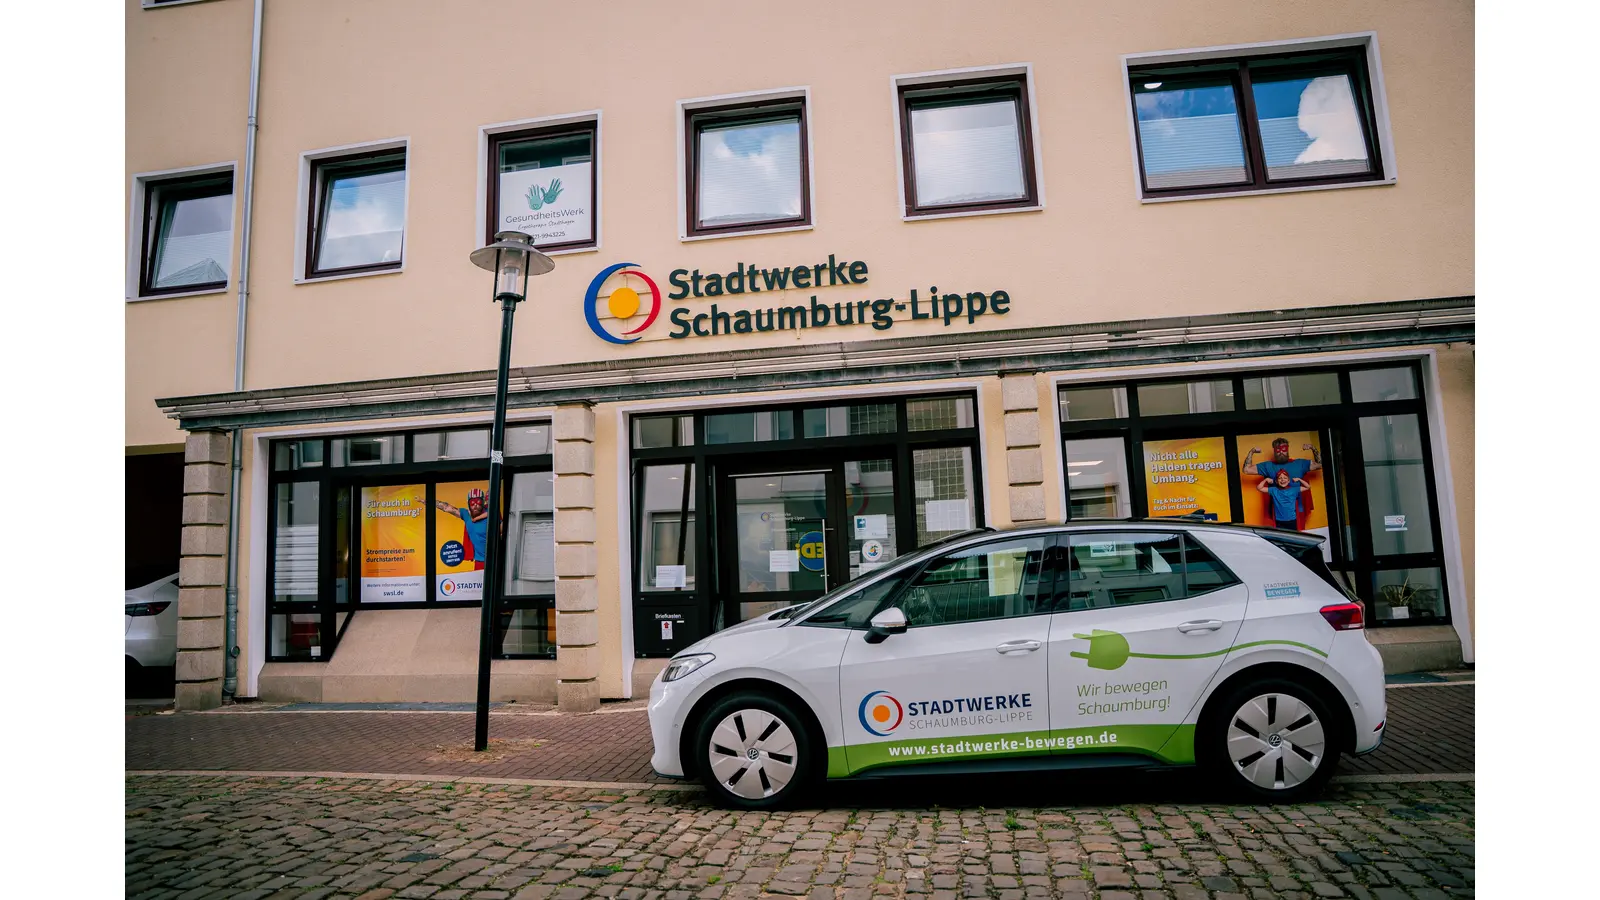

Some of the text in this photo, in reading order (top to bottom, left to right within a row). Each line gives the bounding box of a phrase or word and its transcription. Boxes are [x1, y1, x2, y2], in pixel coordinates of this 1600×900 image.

[505, 207, 585, 224] GesundheitsWerk
[668, 253, 869, 300] Stadtwerke
[669, 285, 1011, 340] Schaumburg-Lippe
[1151, 449, 1198, 462] Nicht alle
[1151, 461, 1222, 473] Helden tragen
[1152, 474, 1198, 484] Umhang.
[367, 498, 410, 508] Für euch in
[456, 582, 483, 590] STADTW
[1077, 680, 1168, 697] Wir bewegen
[908, 692, 1032, 716] STADTWERKE
[1078, 695, 1171, 715] Schaumburg!
[909, 710, 1033, 730] SCHAUMBURG-LIPPE
[888, 731, 1118, 757] www.stadtwerke-bewegen.de
